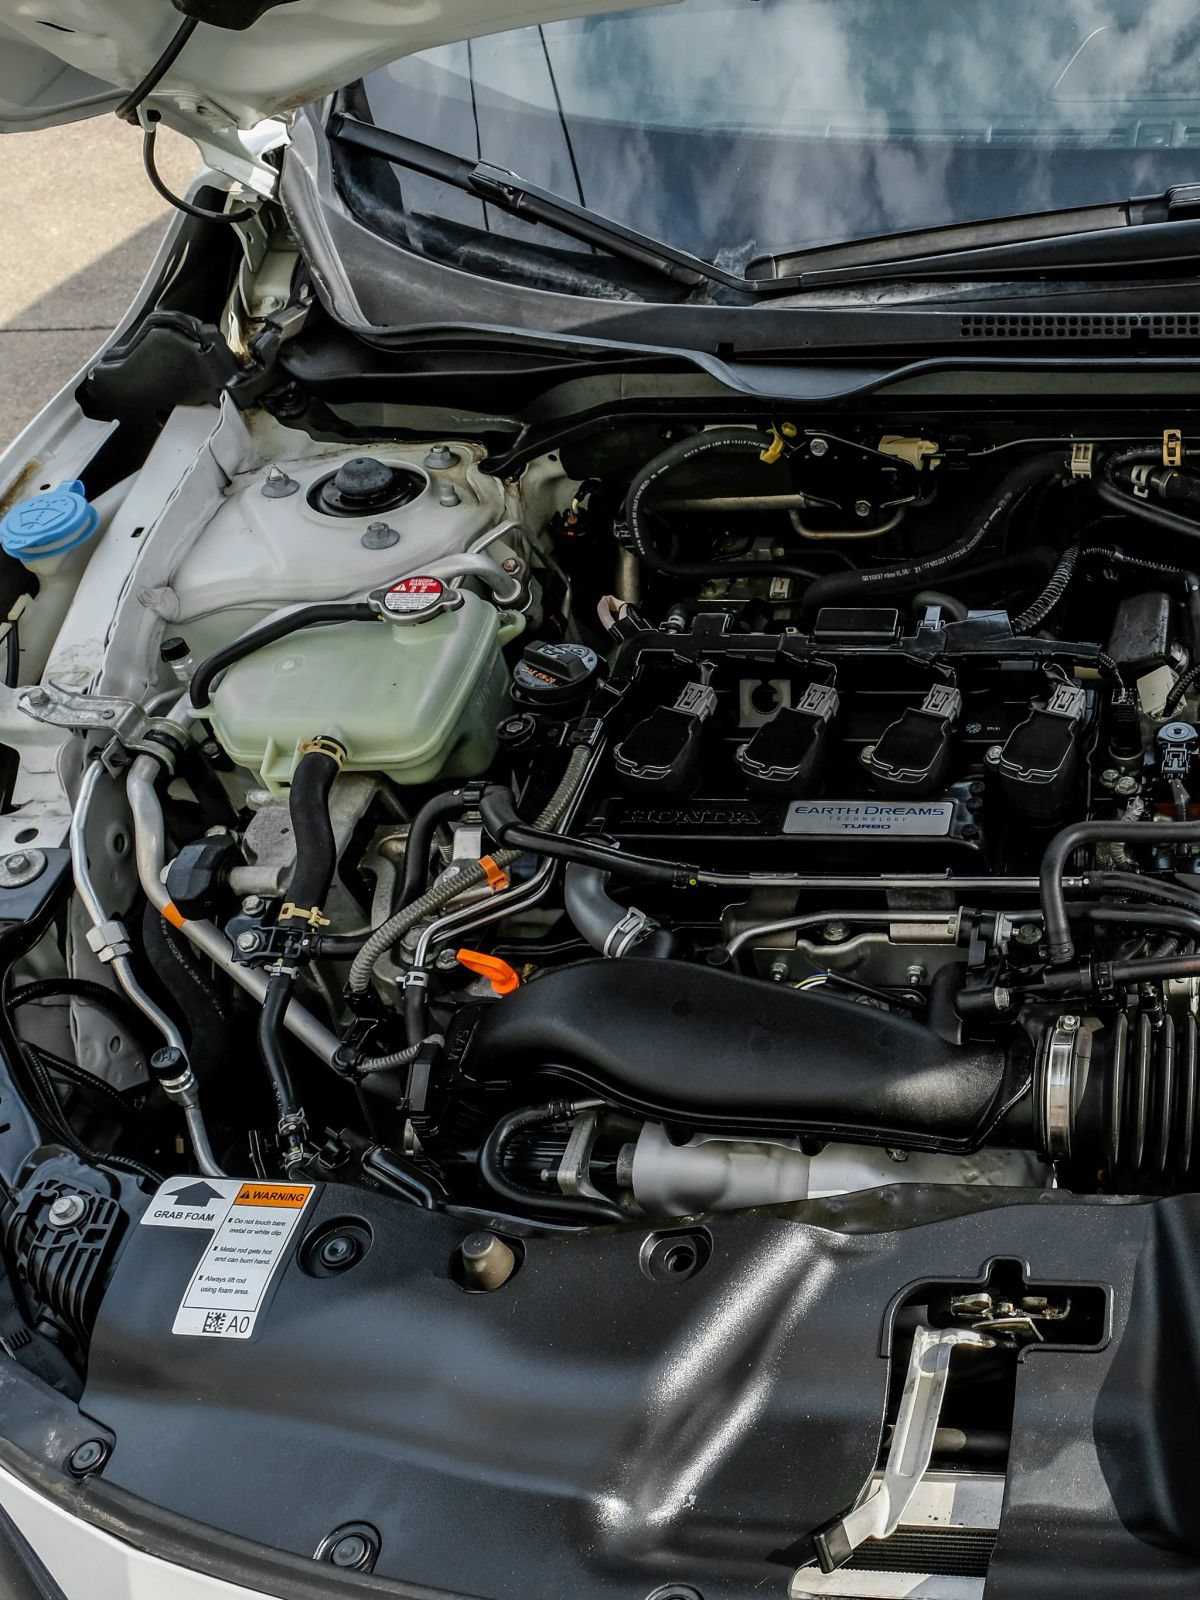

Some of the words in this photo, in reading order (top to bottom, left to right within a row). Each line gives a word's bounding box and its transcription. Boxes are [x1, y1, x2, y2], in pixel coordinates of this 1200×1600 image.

[794, 806, 859, 814] EARTH
[864, 806, 945, 816] DREAMS
[620, 810, 762, 825] HONDA
[252, 1191, 304, 1202] WARNING
[154, 1210, 182, 1220] GRAB
[184, 1212, 216, 1222] FOAM
[225, 1316, 250, 1333] A0
